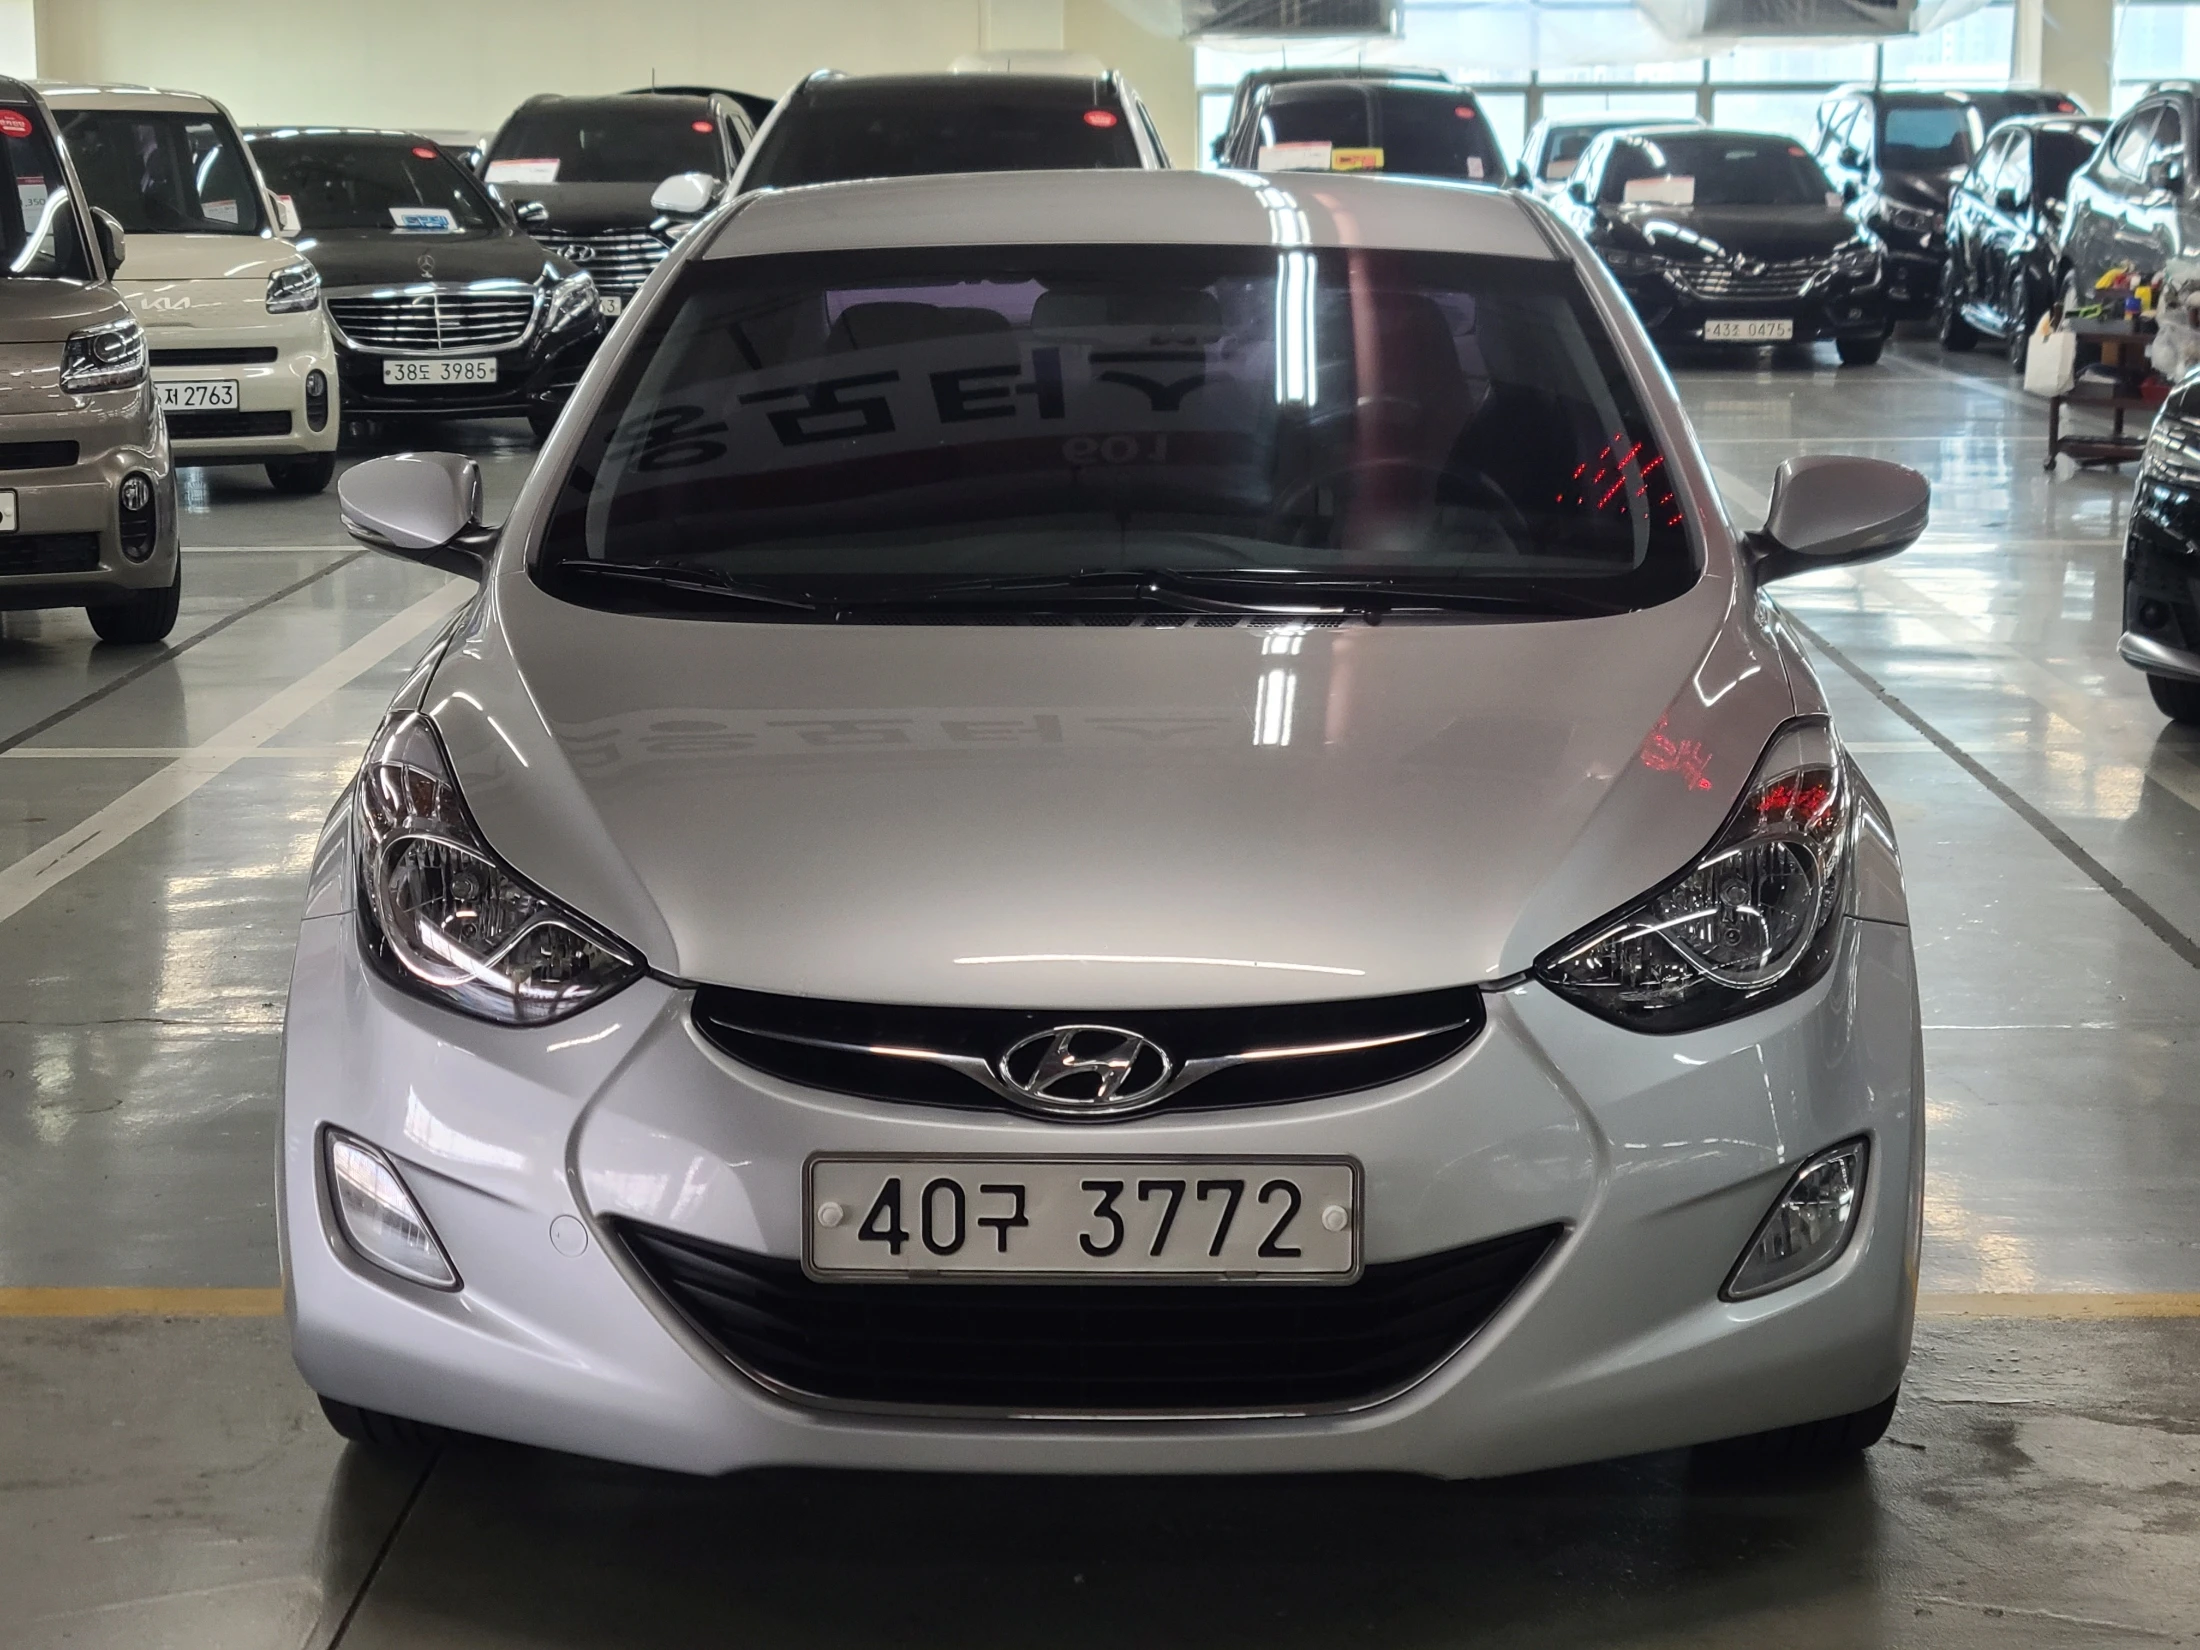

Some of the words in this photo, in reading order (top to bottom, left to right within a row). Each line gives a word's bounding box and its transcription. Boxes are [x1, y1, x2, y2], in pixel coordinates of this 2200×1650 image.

[1748, 322, 1785, 336] 0475
[394, 364, 431, 381] 38도
[440, 362, 486, 380] 3985
[184, 386, 233, 406] 2763
[858, 1178, 1029, 1256] 40구
[1079, 1179, 1302, 1258] 3772
